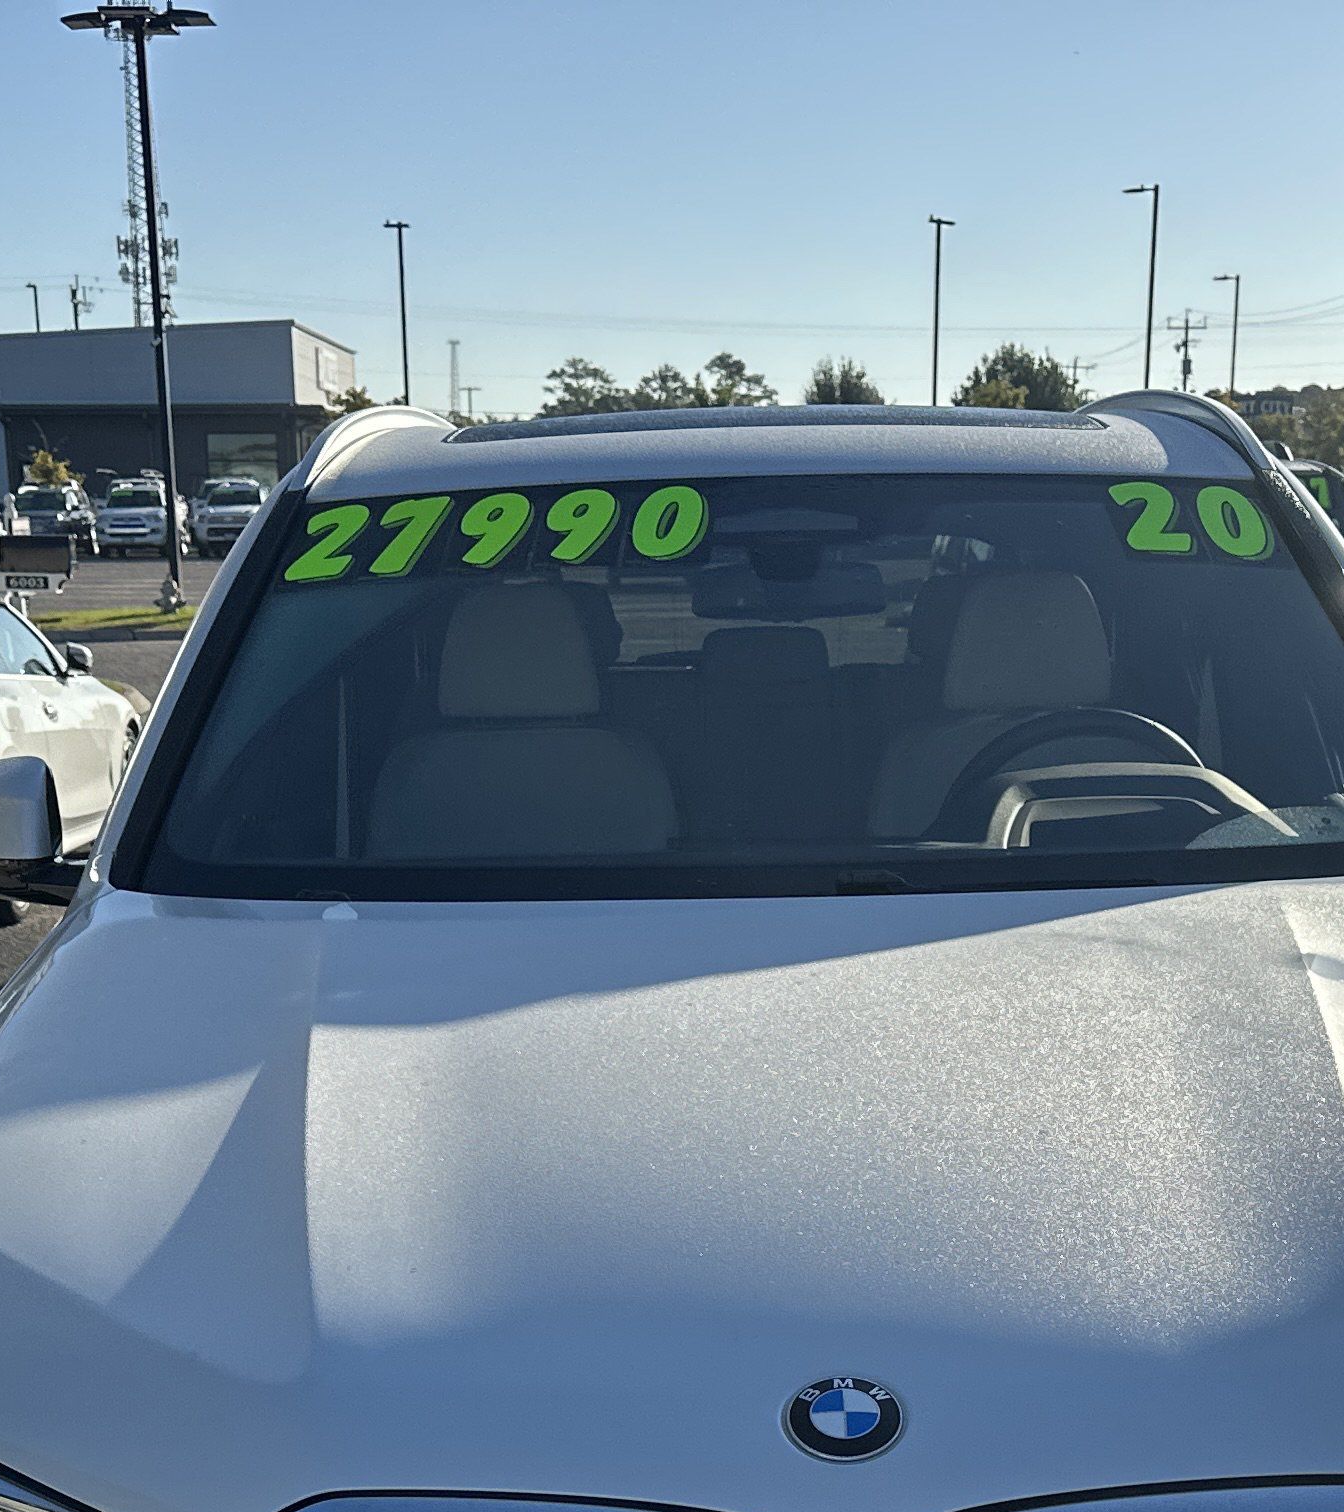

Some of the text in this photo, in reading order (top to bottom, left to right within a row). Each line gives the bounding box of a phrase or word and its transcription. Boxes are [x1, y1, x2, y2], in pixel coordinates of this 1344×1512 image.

[284, 486, 709, 583] 27990
[1108, 481, 1274, 561] 20
[9, 575, 46, 589] 6003
[798, 1378, 892, 1402] BMW
